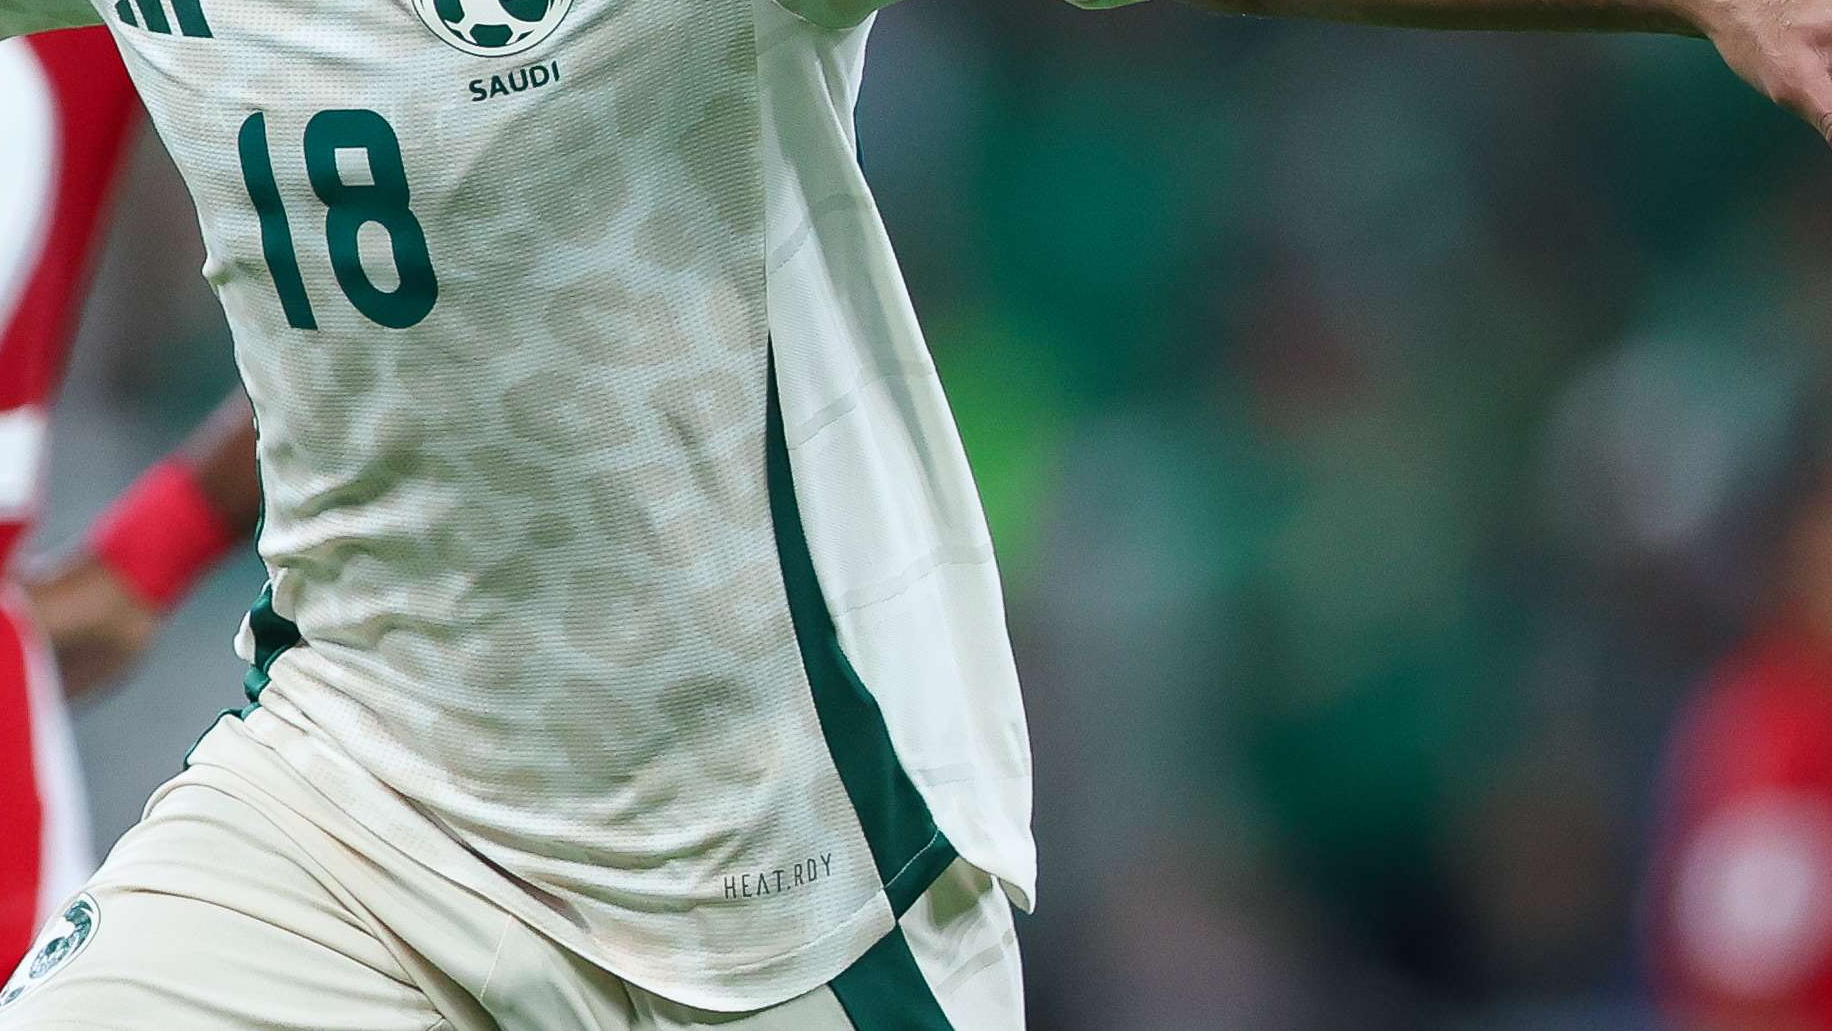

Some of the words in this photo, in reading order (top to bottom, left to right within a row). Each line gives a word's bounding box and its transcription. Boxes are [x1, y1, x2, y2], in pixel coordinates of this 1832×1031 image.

[469, 60, 560, 101] SAUDI
[238, 109, 439, 330] 18
[724, 853, 832, 899] HEAT.RDY
